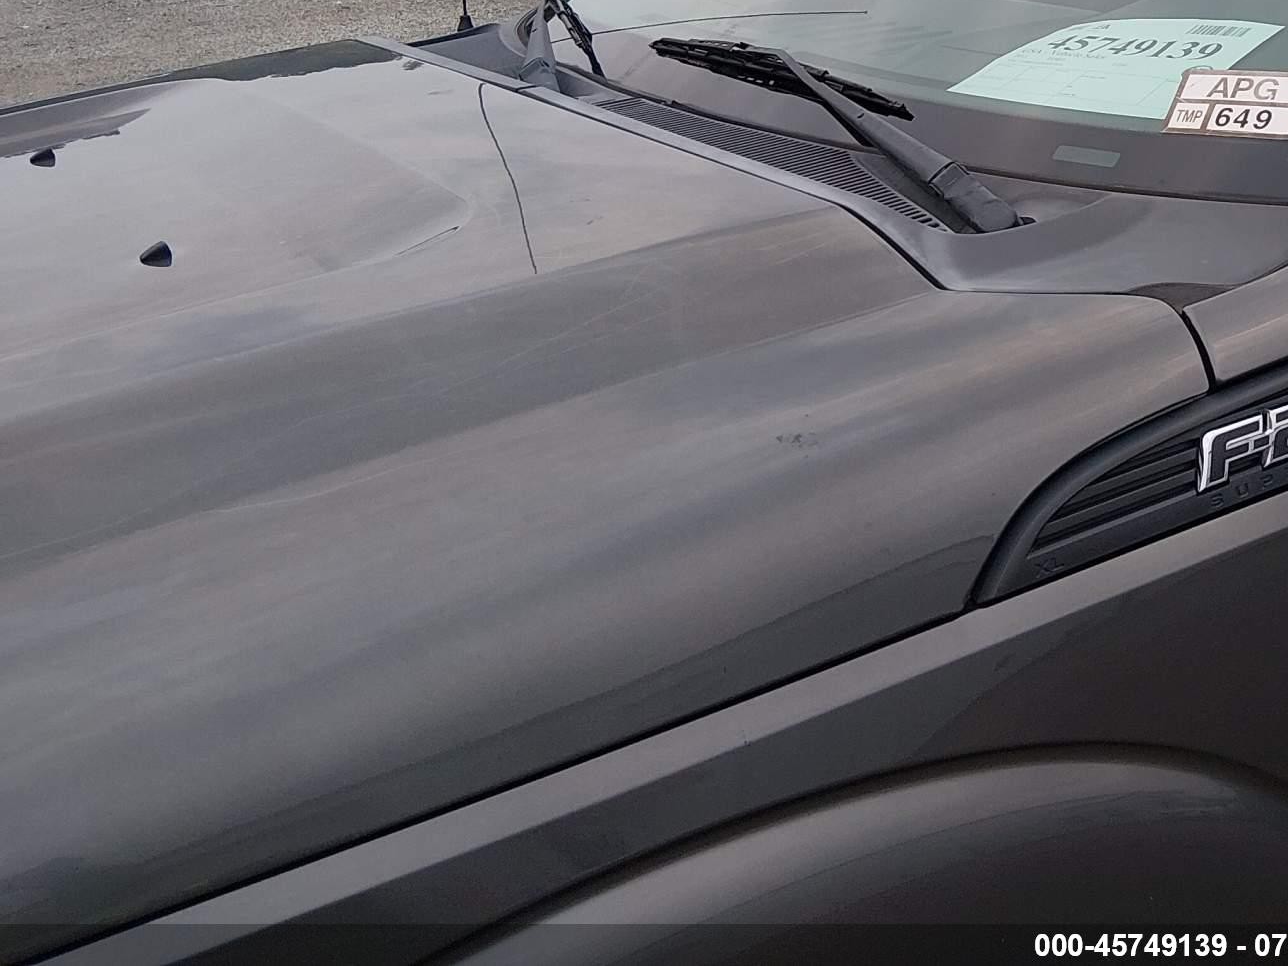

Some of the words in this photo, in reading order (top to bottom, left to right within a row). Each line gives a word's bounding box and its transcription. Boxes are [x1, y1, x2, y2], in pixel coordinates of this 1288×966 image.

[1048, 34, 1224, 61] 45749139
[1206, 76, 1280, 101] APG
[1176, 109, 1203, 124] TMP
[1214, 107, 1273, 130] 649
